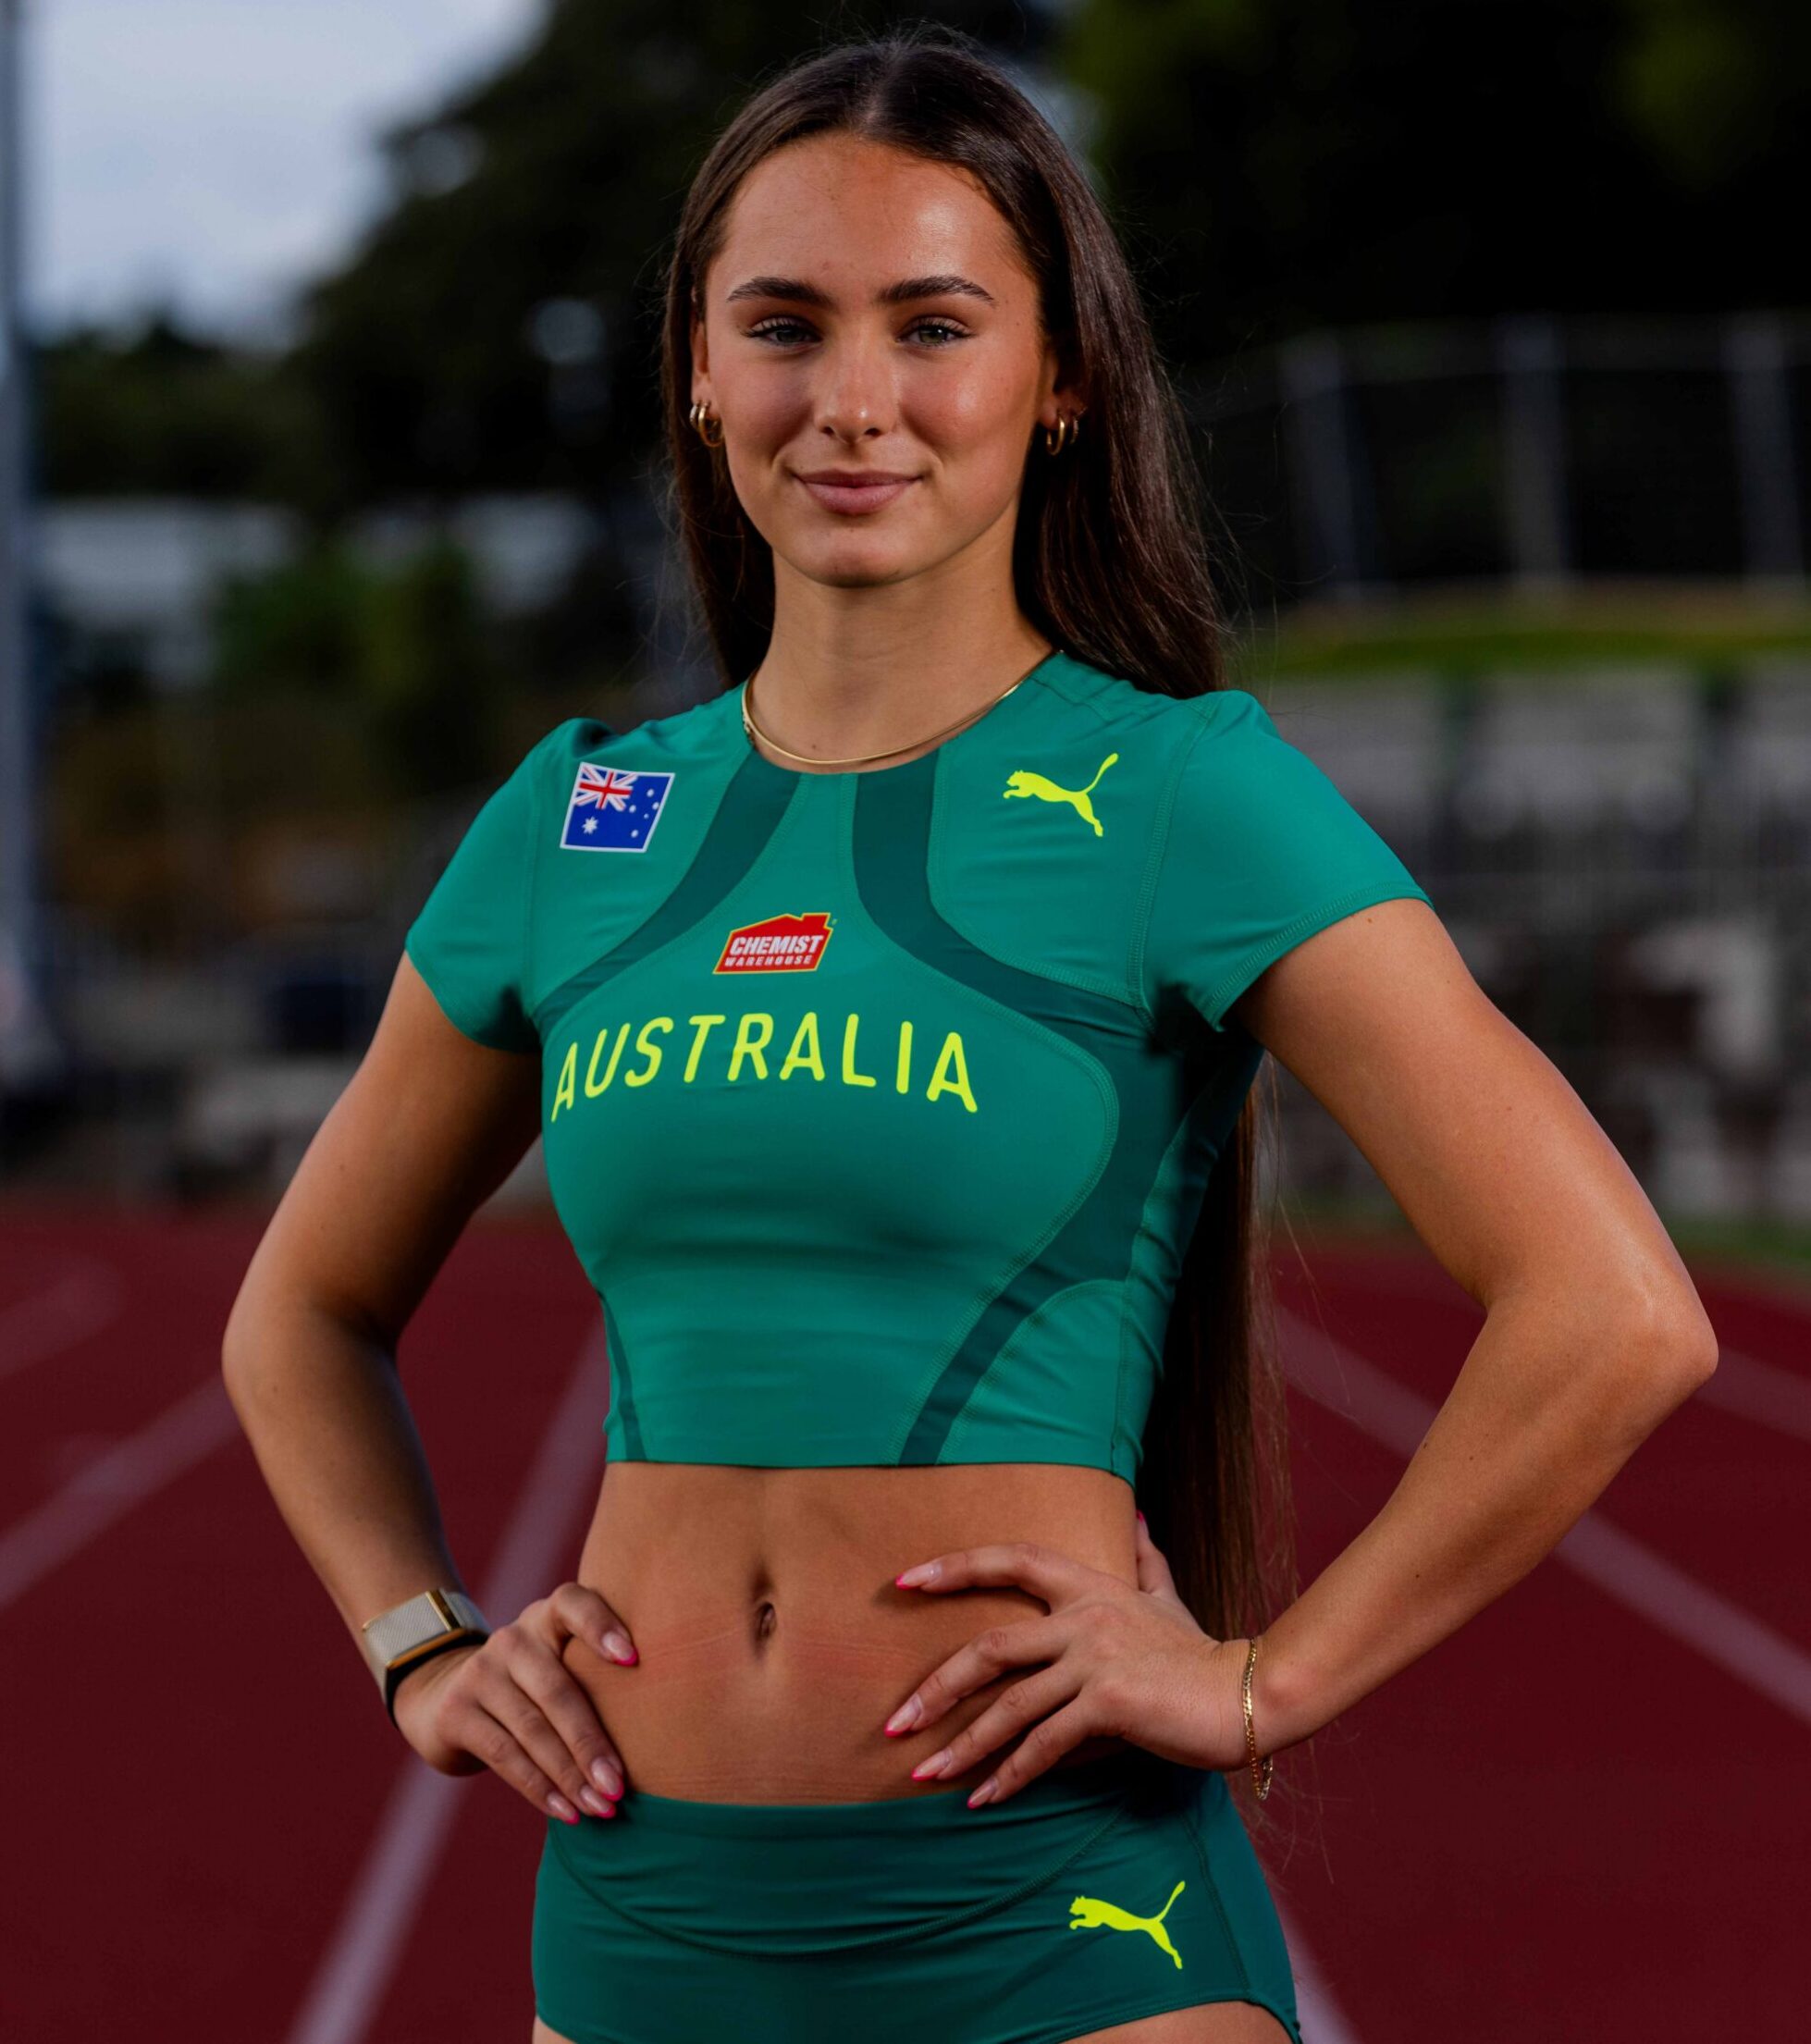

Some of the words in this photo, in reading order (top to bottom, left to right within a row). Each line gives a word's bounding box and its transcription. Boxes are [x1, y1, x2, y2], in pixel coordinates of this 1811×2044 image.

[730, 935, 823, 955] CHEMIST
[725, 955, 812, 967] WAREHOUSE
[550, 1012, 979, 1123] AUSTRALIA
